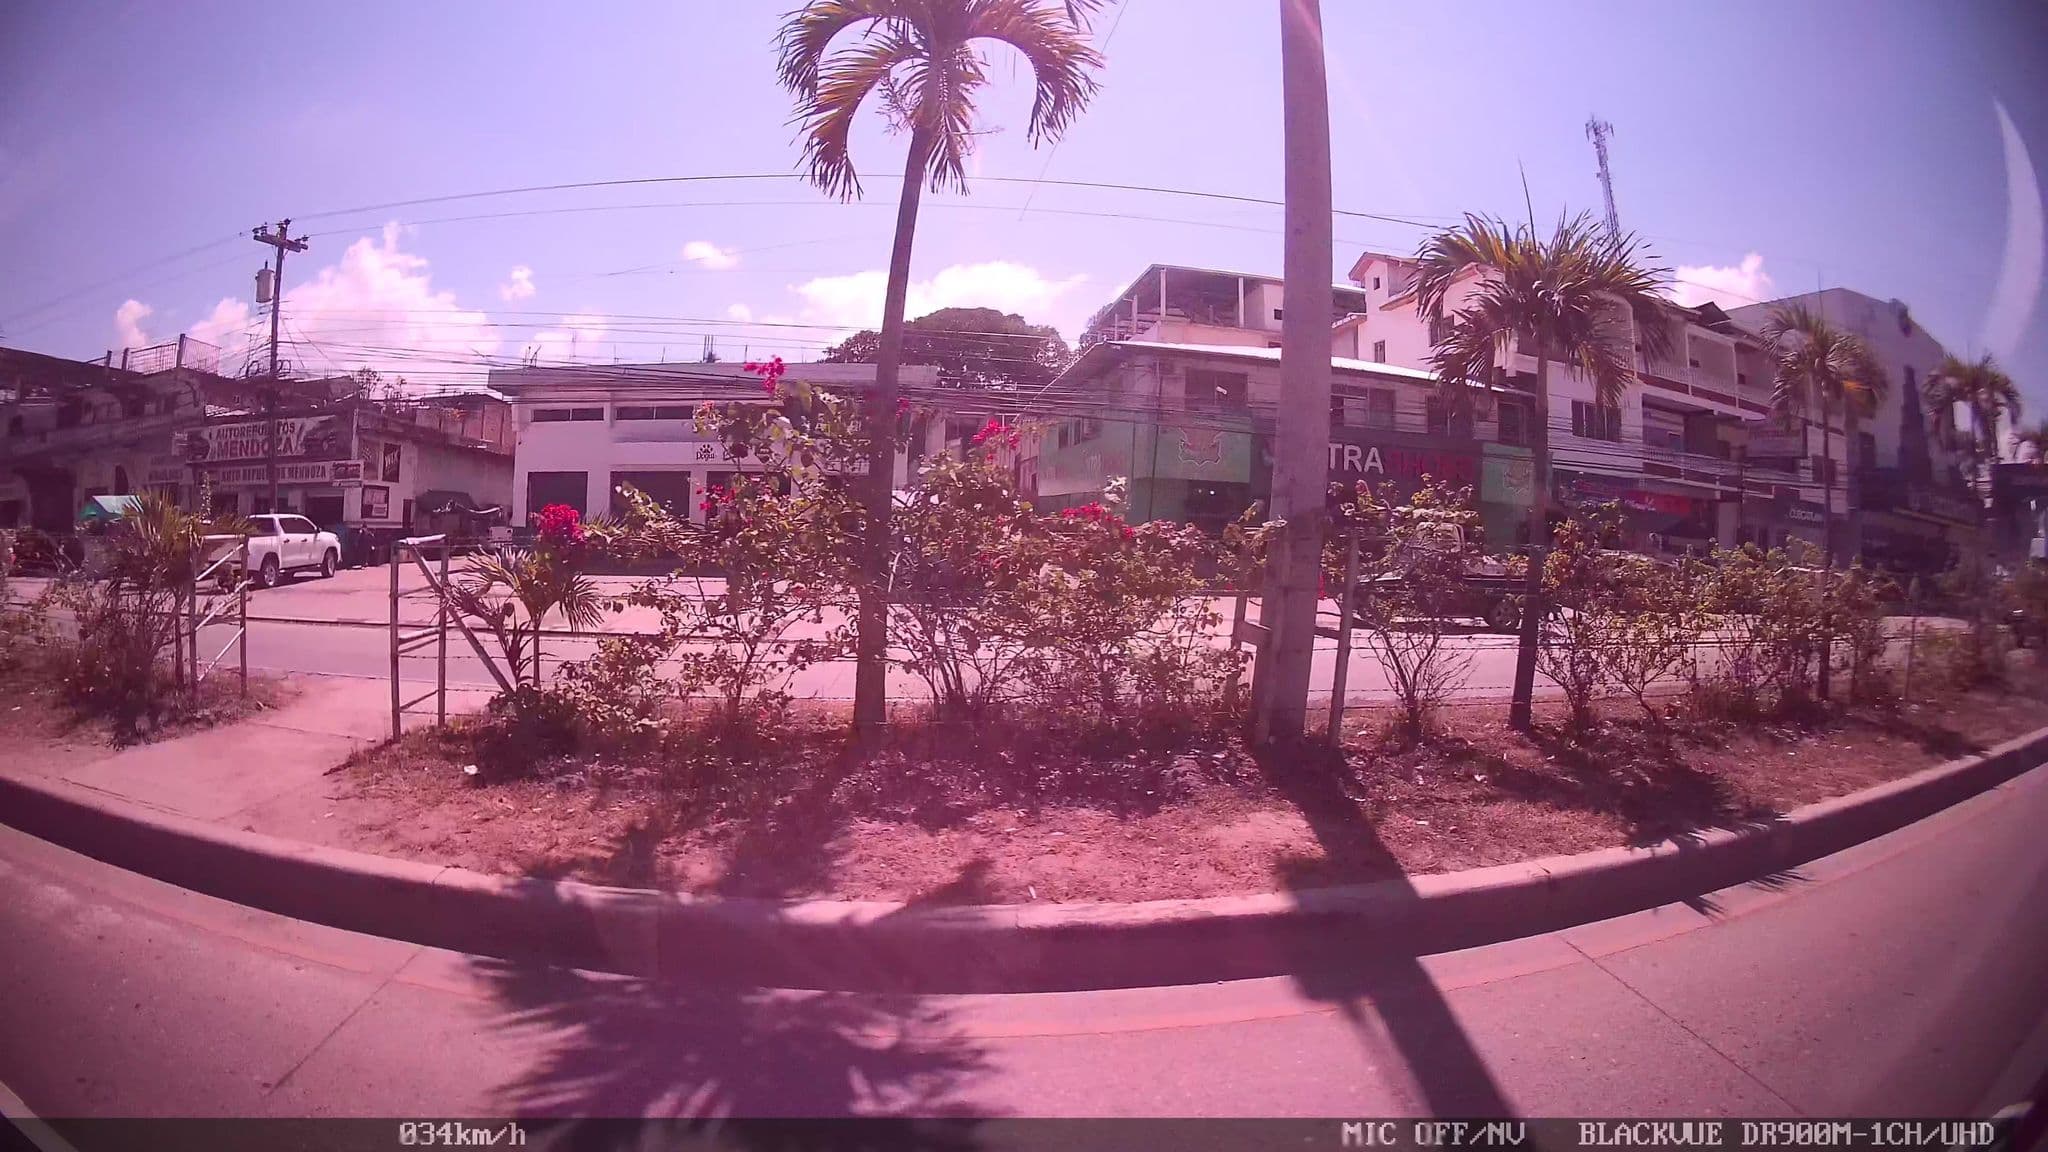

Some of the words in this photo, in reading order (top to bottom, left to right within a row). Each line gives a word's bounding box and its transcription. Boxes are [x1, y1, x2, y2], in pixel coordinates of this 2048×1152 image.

[215, 421, 295, 440] AUTOREPUTOS
[216, 437, 294, 461] MENDOA
[1328, 442, 1384, 474] TRA
